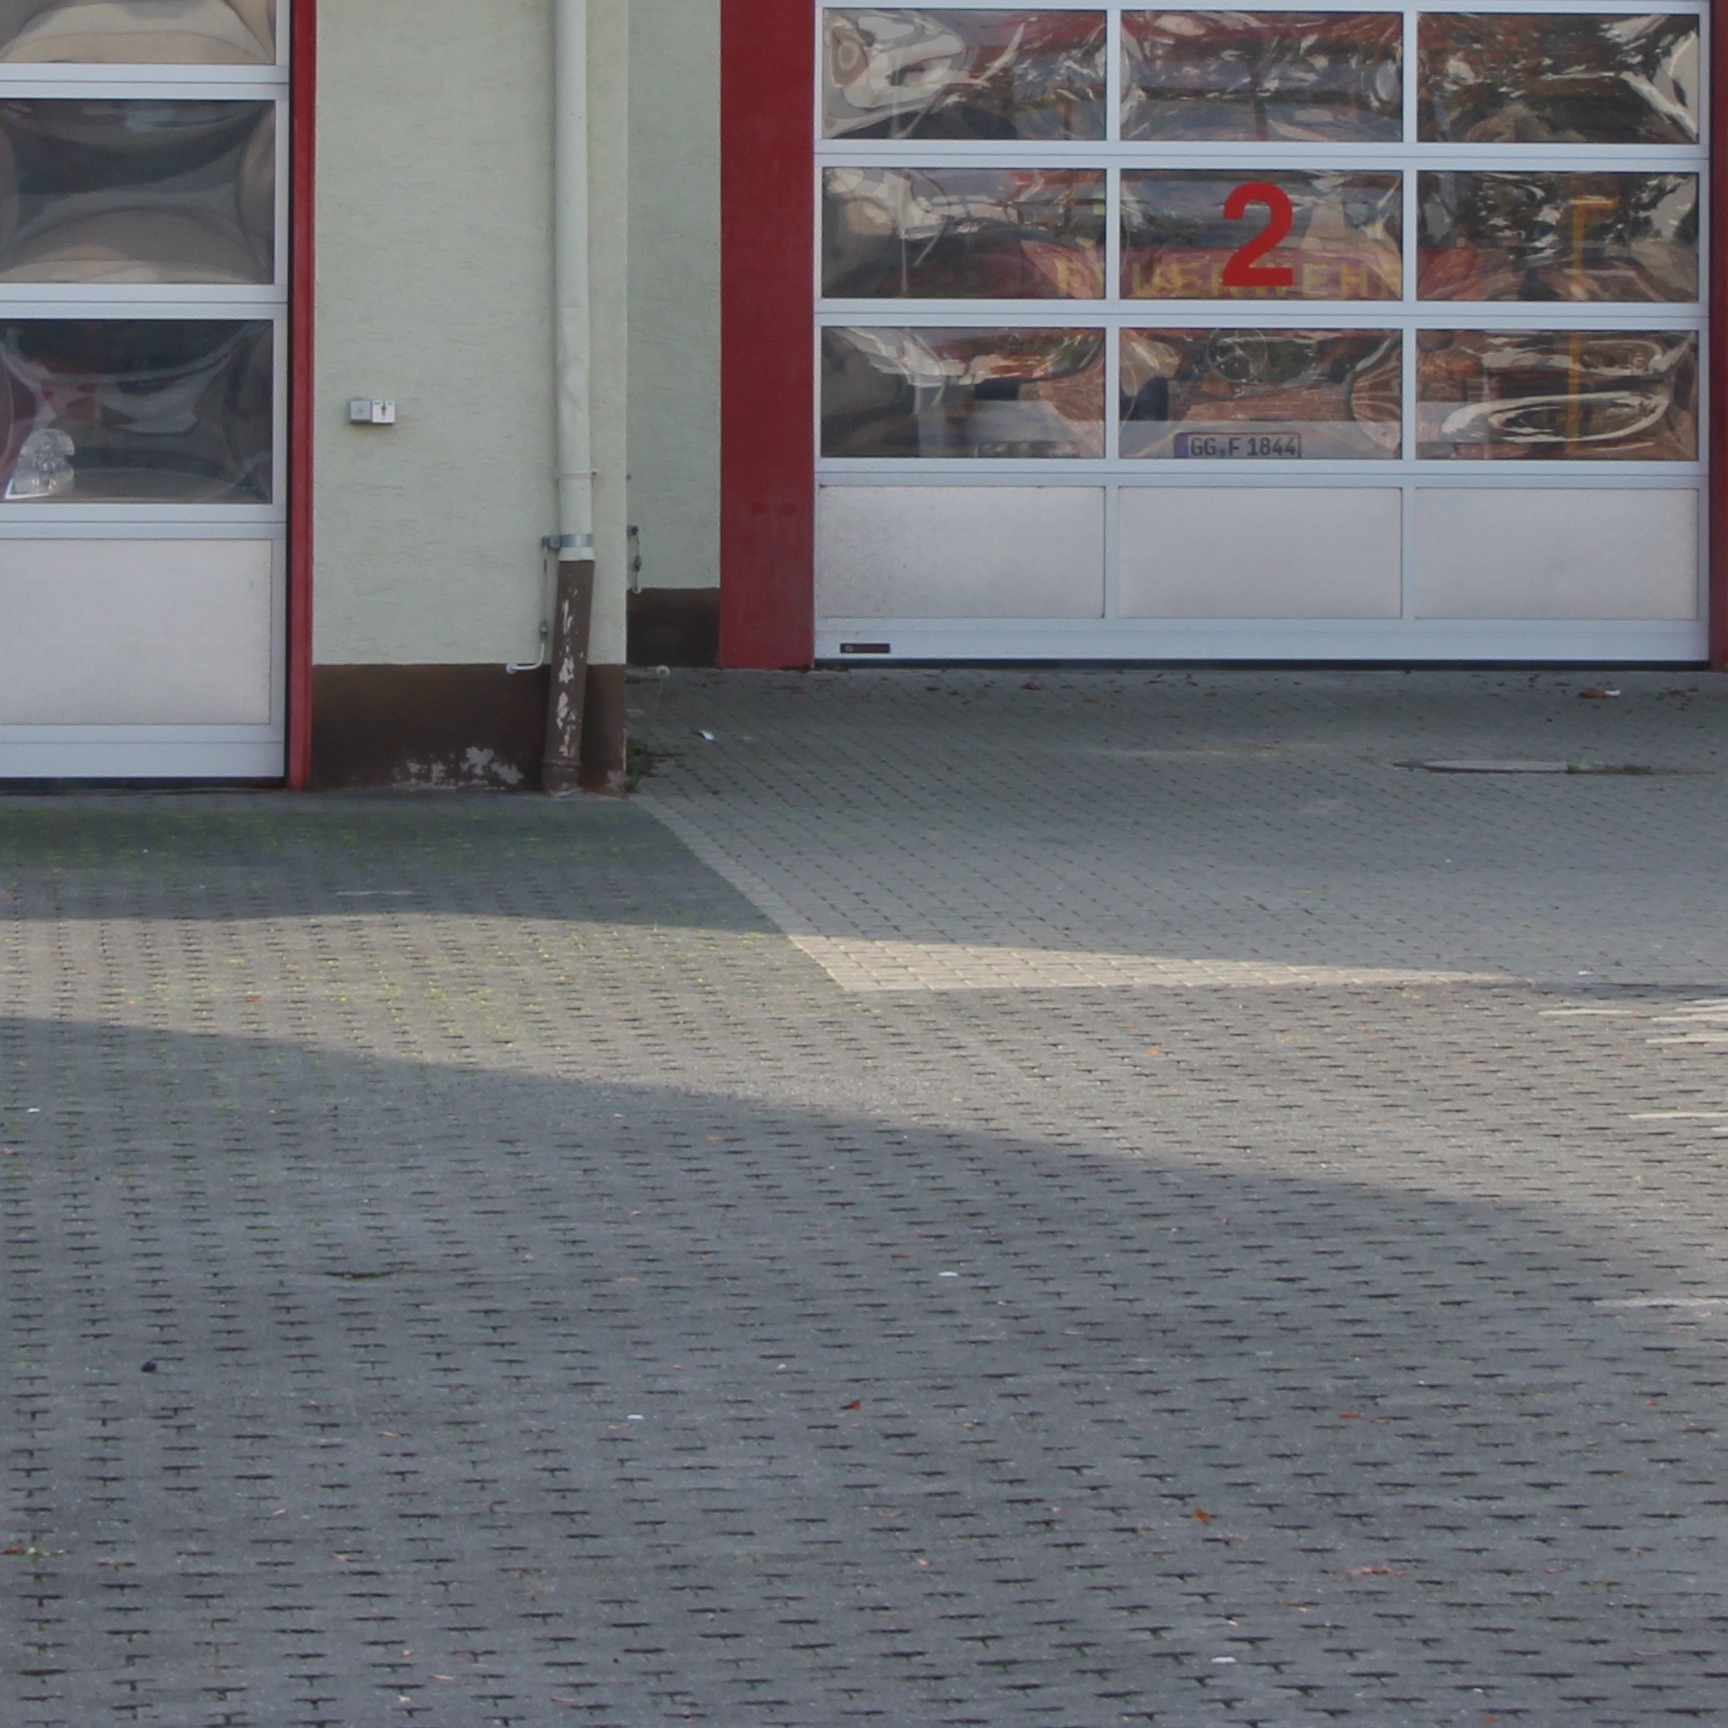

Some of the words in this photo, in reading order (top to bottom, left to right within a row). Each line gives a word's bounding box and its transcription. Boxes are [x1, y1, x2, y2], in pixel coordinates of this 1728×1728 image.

[1223, 181, 1294, 286] 2
[1057, 261, 1403, 299] FUEEHR
[1246, 437, 1296, 456] 1844
